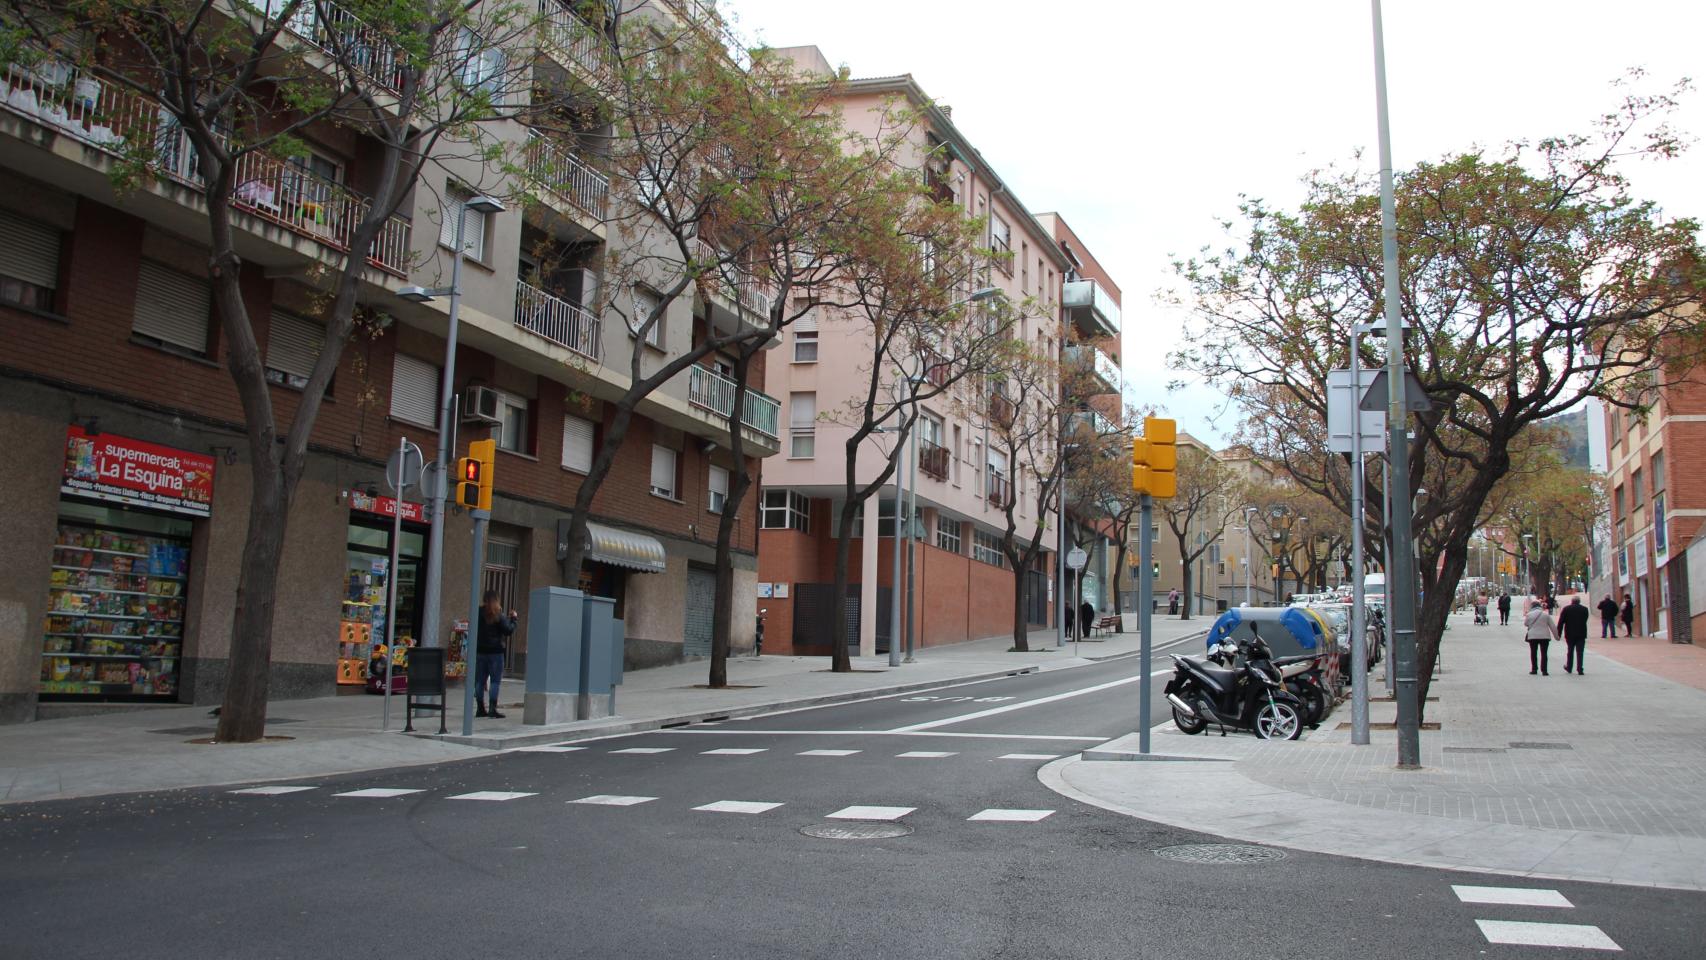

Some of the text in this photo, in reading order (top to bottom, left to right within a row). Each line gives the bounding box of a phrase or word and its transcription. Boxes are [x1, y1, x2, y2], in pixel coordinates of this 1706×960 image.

[105, 445, 180, 469] supermercat
[101, 457, 183, 490] La Esquina
